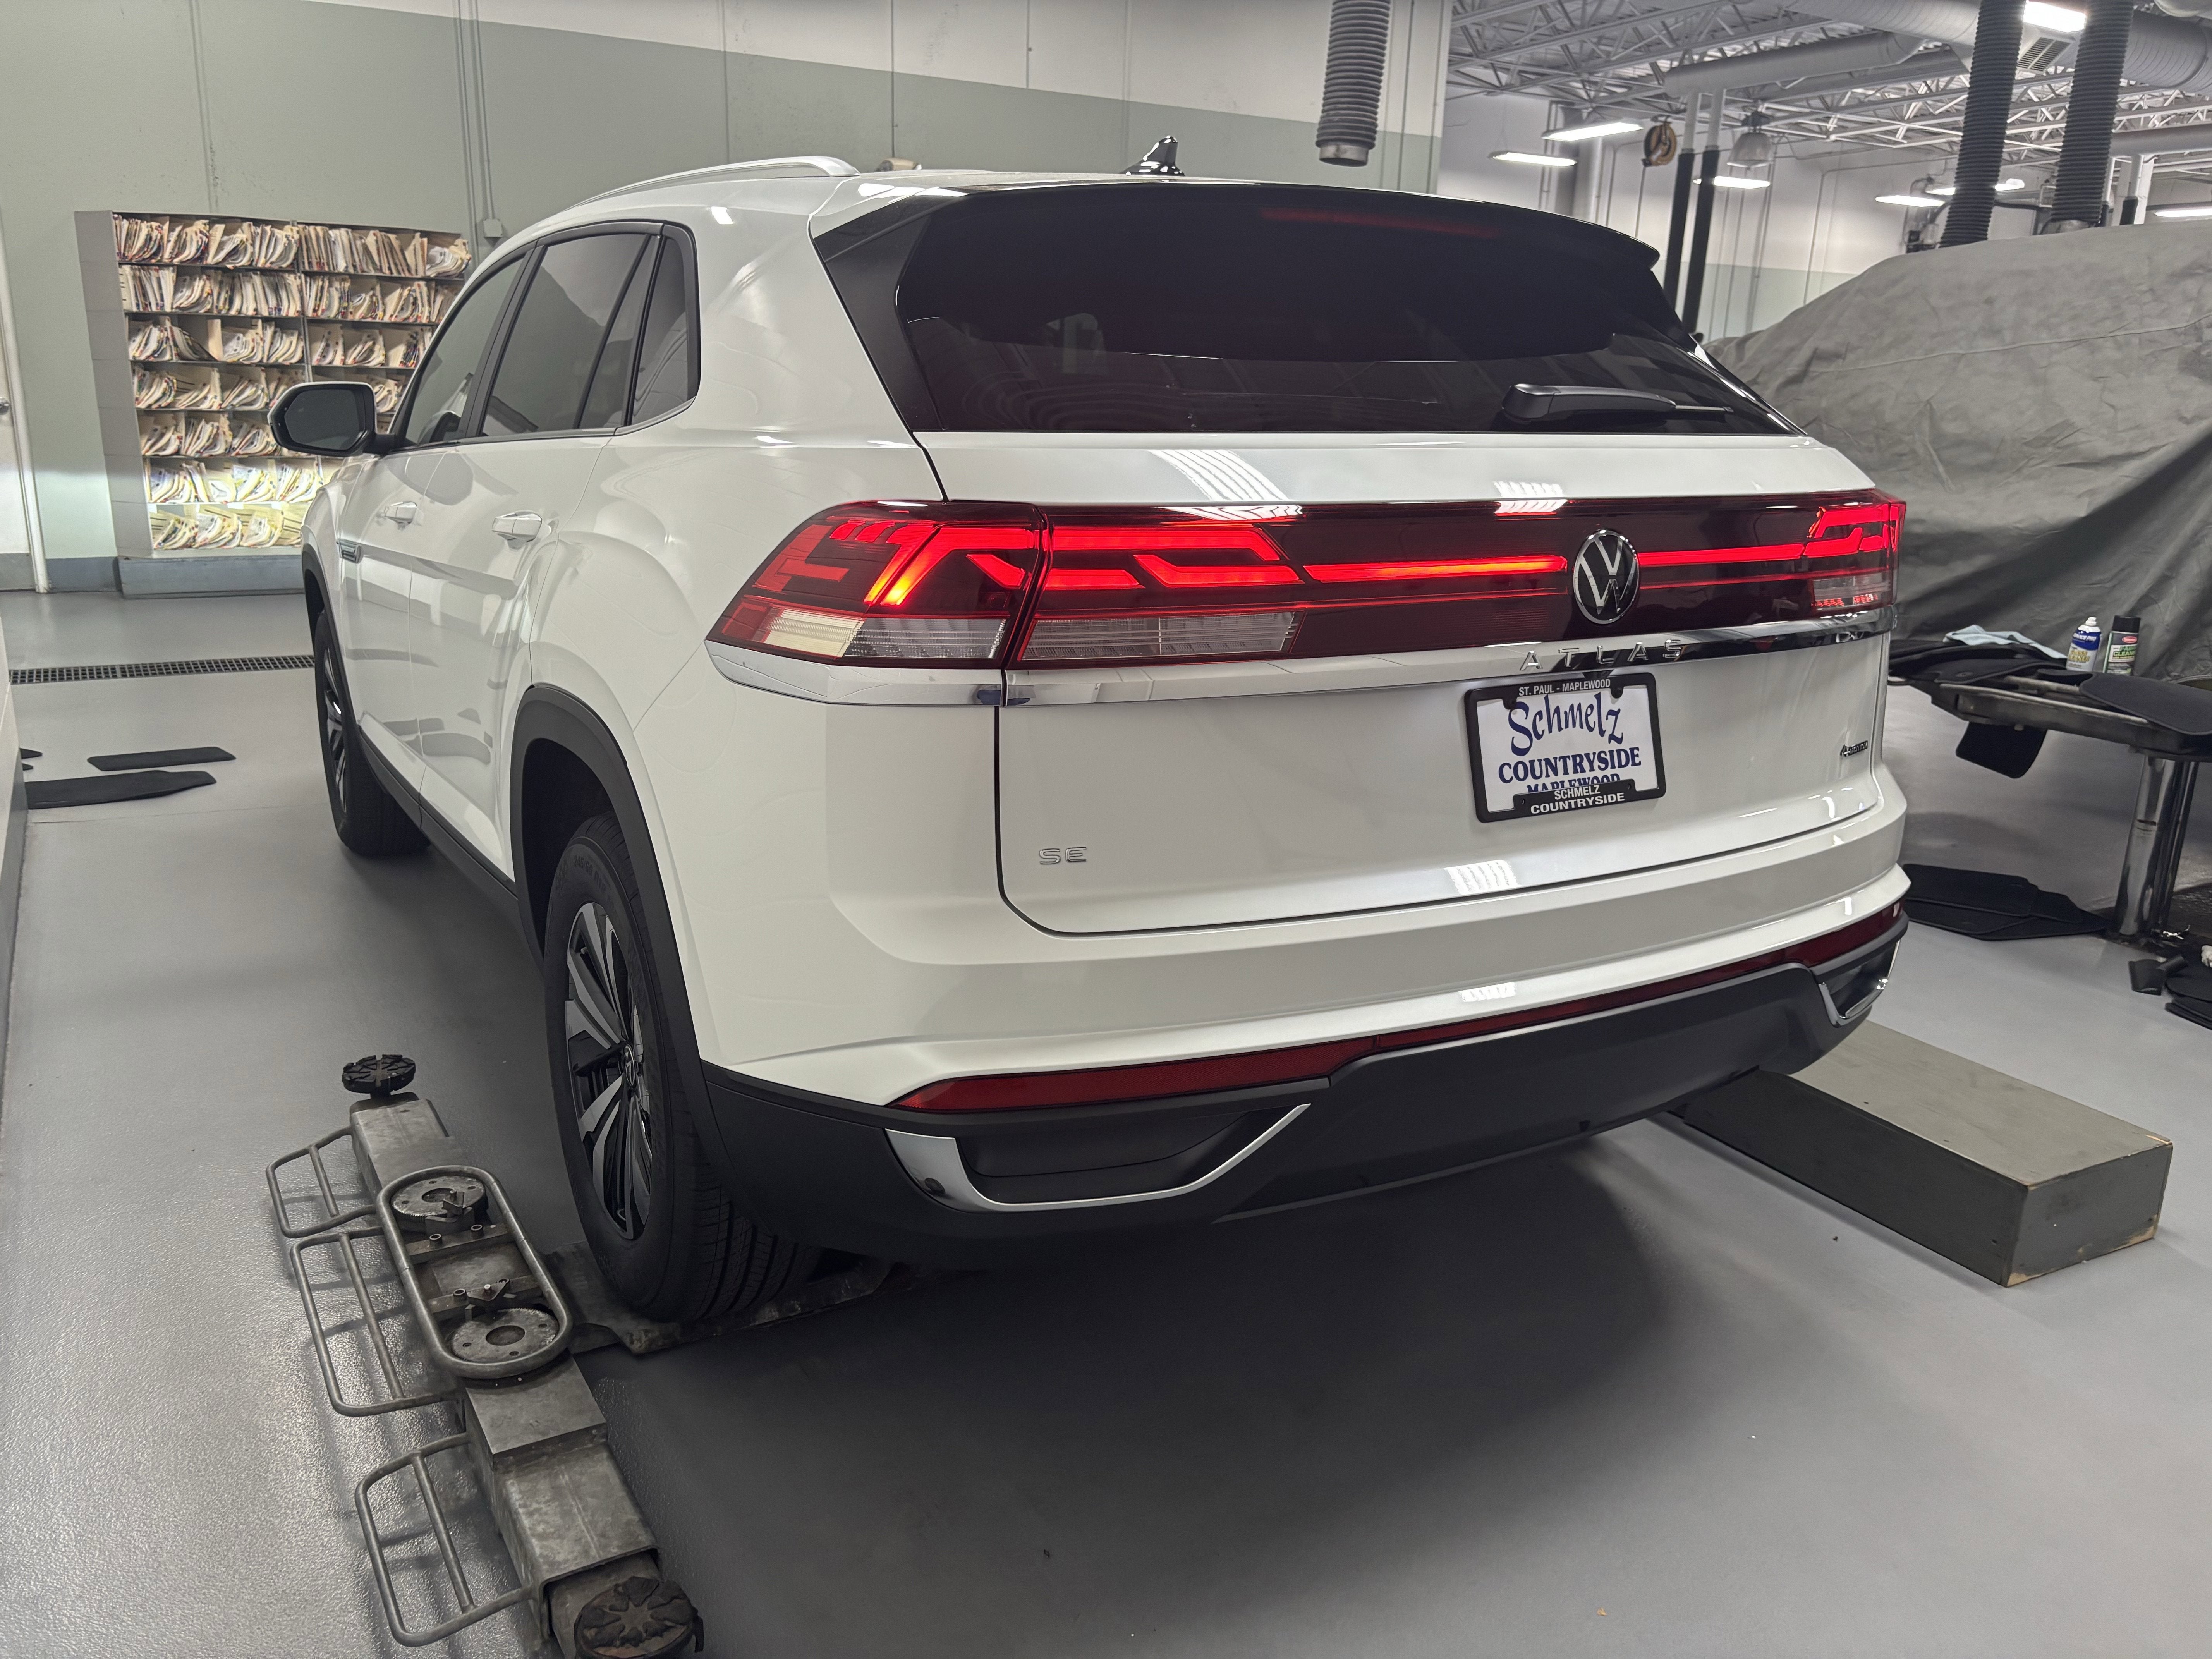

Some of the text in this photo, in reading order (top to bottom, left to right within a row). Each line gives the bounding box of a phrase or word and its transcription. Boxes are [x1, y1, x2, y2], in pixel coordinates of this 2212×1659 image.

[1573, 529, 1639, 625] VW
[1519, 639, 1682, 671] ATLAS
[1518, 687, 1532, 696] ST.
[1534, 684, 1554, 694] PAUL
[1562, 678, 1611, 692] MAPLEWOOD
[1508, 692, 1623, 757] Schmelz
[1498, 747, 1642, 784] COUNTRYSIDE
[1530, 792, 1625, 814] COUNTRYSIDE
[1554, 785, 1601, 800] SCHMELZ
[1039, 847, 1087, 864] SE
